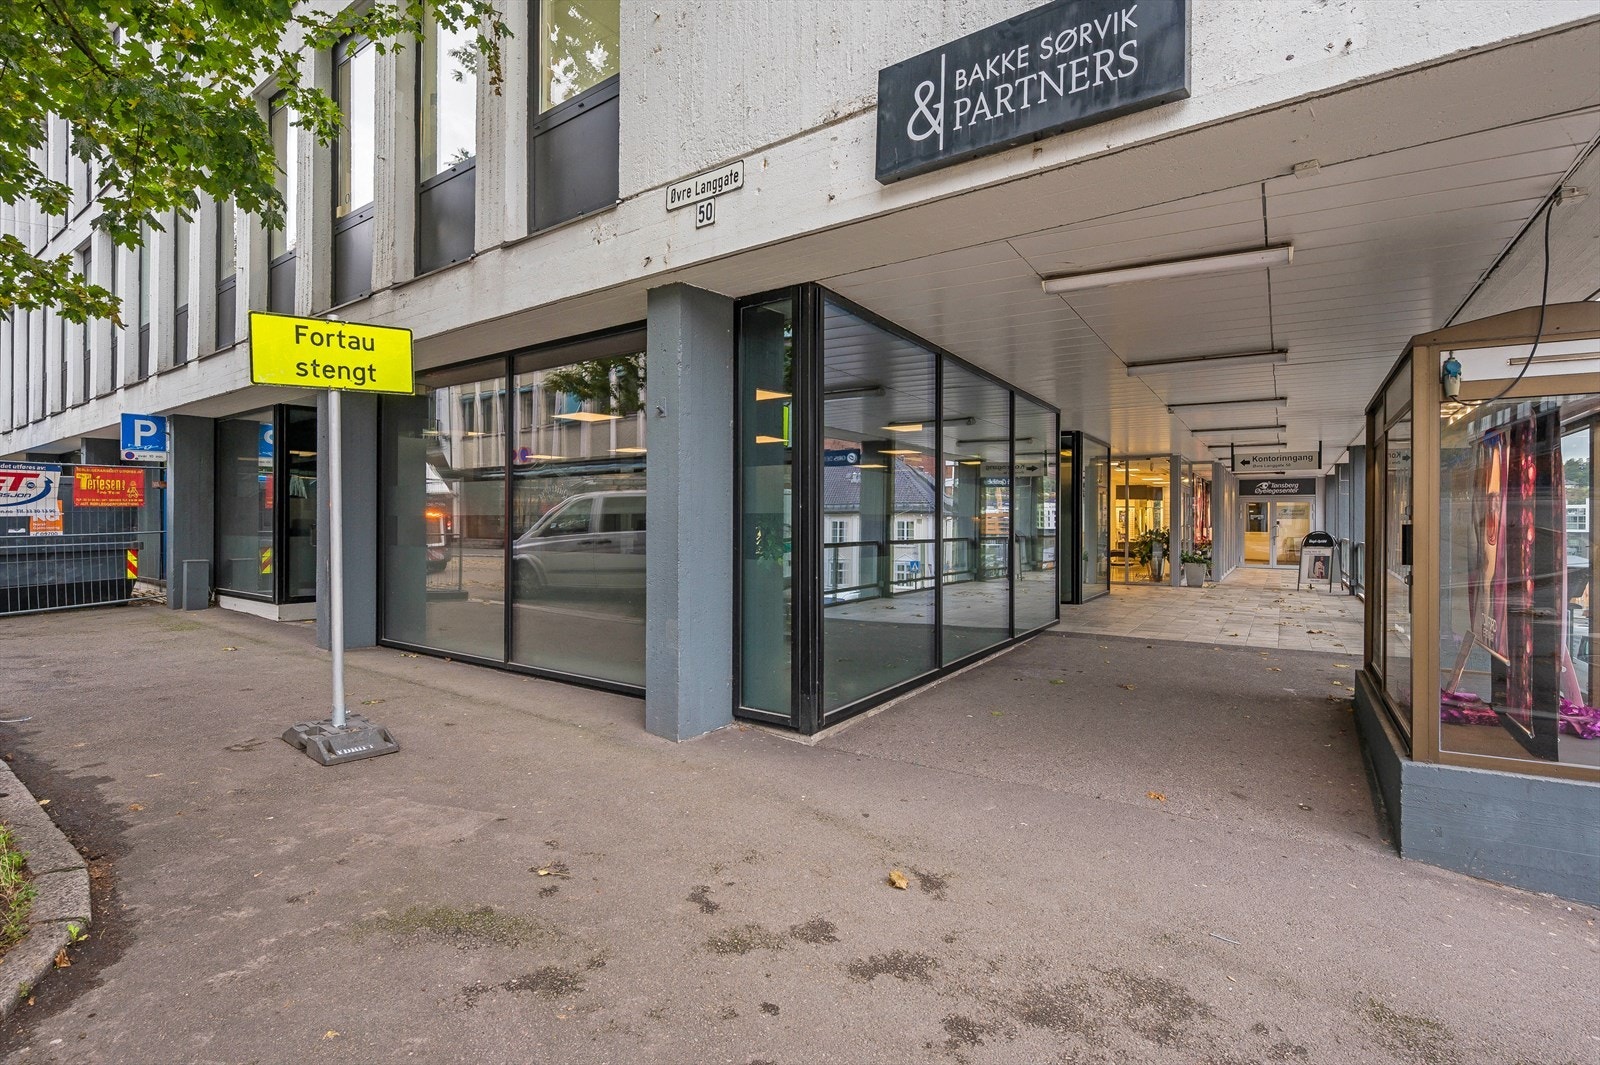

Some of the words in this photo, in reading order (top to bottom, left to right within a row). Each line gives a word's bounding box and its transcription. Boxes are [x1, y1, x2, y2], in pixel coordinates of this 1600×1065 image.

[955, 44, 1029, 91] BAKKE
[1039, 4, 1138, 60] SØRVIK
[907, 80, 944, 141] &
[952, 39, 1138, 131] PARTNERS
[670, 187, 692, 204] Øvre
[695, 169, 739, 194] Langgate
[698, 202, 713, 223] 50
[295, 324, 375, 352] Fortau
[296, 358, 377, 386] stengt
[134, 419, 157, 446] P
[1251, 453, 1314, 463] Kontorinngang
